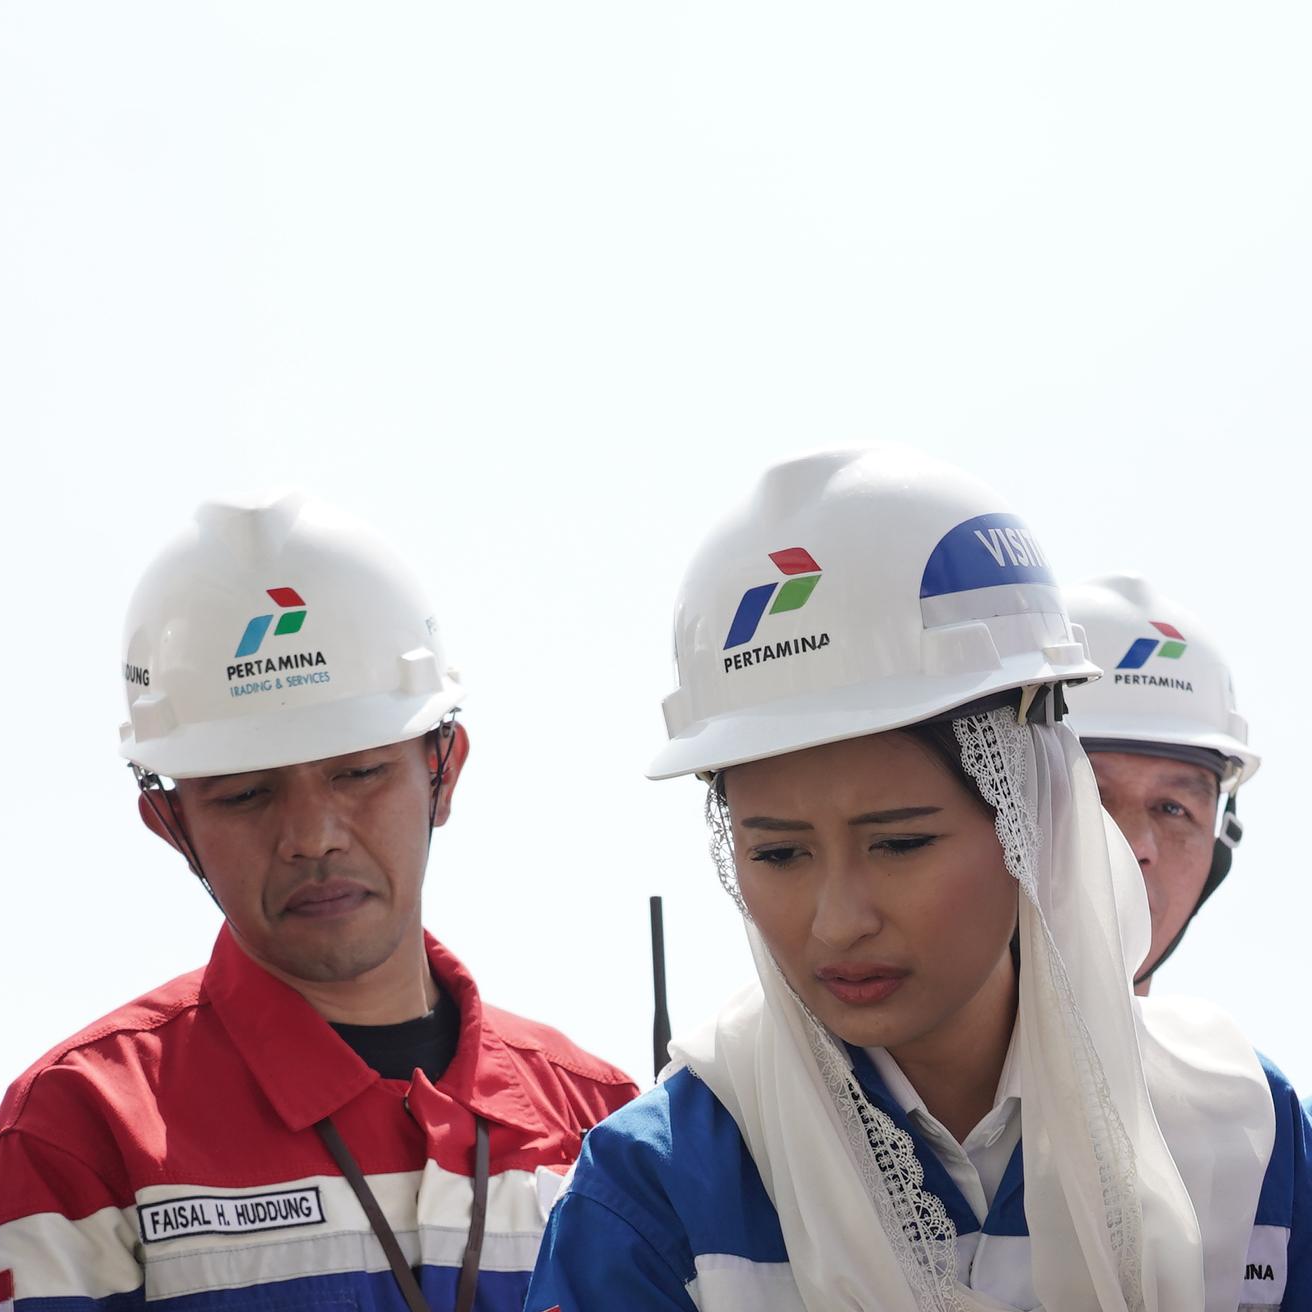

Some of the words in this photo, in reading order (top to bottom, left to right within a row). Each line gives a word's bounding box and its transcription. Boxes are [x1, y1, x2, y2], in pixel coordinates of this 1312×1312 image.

[973, 527, 1051, 567] VISIT
[227, 651, 327, 681] PERTAMINA
[723, 633, 830, 674] PERTAMINA
[275, 677, 283, 689] &
[286, 671, 330, 688] SERVICES
[1114, 673, 1193, 693] PERTAMINA
[151, 1203, 211, 1235] FAISAL
[215, 1204, 230, 1227] H.
[235, 1196, 312, 1227] HUDDUNG
[1244, 1263, 1275, 1281] INA
